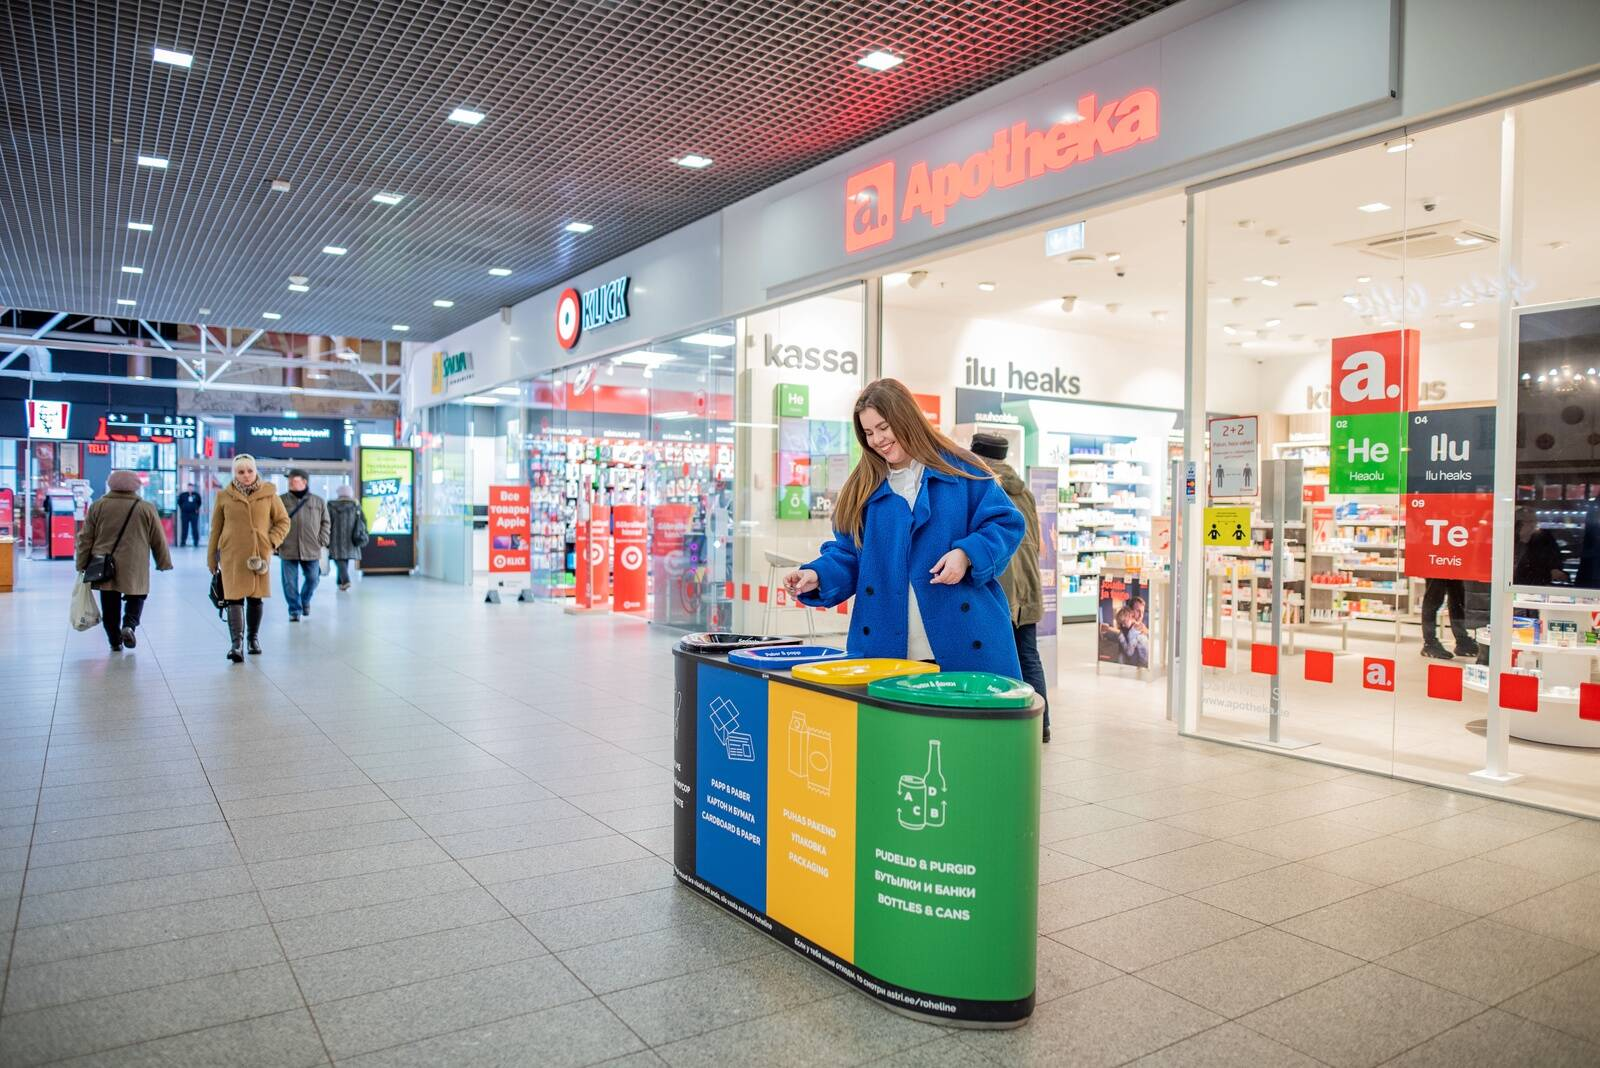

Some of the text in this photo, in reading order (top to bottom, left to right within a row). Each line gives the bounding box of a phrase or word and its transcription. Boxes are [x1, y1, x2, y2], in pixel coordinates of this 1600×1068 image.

[900, 88, 1161, 227] Apotheka
[582, 276, 630, 331] KLICK
[764, 333, 859, 375] kassa
[965, 357, 1081, 395] ilu heaks
[1339, 350, 1400, 403] a.
[1222, 424, 1244, 437] 2+2
[1336, 420, 1348, 429] 02
[1414, 416, 1428, 425] 04
[1347, 437, 1389, 464] He
[1430, 433, 1470, 462] Ilu
[1349, 470, 1385, 481] Heaolu
[1426, 470, 1472, 481] Ilu heaks
[500, 491, 520, 501] Все
[1411, 499, 1425, 508] 09
[490, 505, 530, 516] товары
[496, 517, 526, 528] Apple
[1425, 519, 1469, 547] Te
[1428, 554, 1463, 566] Tervis
[1366, 662, 1392, 686] a.
[711, 778, 751, 802] PAPP & PABER
[904, 792, 913, 801] A
[928, 787, 937, 796] D
[706, 795, 755, 824] КАРТОН И БУМАГА
[913, 806, 921, 815] C
[930, 808, 939, 818] B
[701, 811, 761, 846] CARDBOARD & PAPER
[783, 808, 837, 838] PUHAS PAKEND
[791, 831, 827, 856] УПАКОВКА
[788, 851, 829, 878] PACKAGING
[875, 848, 976, 875] PUDELID & PURGID
[875, 870, 976, 898] БУТЫЛКИ И БАНКИ
[878, 893, 970, 920] BOTTLES & CANS
[794, 937, 806, 951] Если
[810, 946, 822, 960] тебя
[856, 973, 863, 984] то
[863, 980, 886, 996] смотри
[886, 989, 957, 1014] astri.ee/roheline
